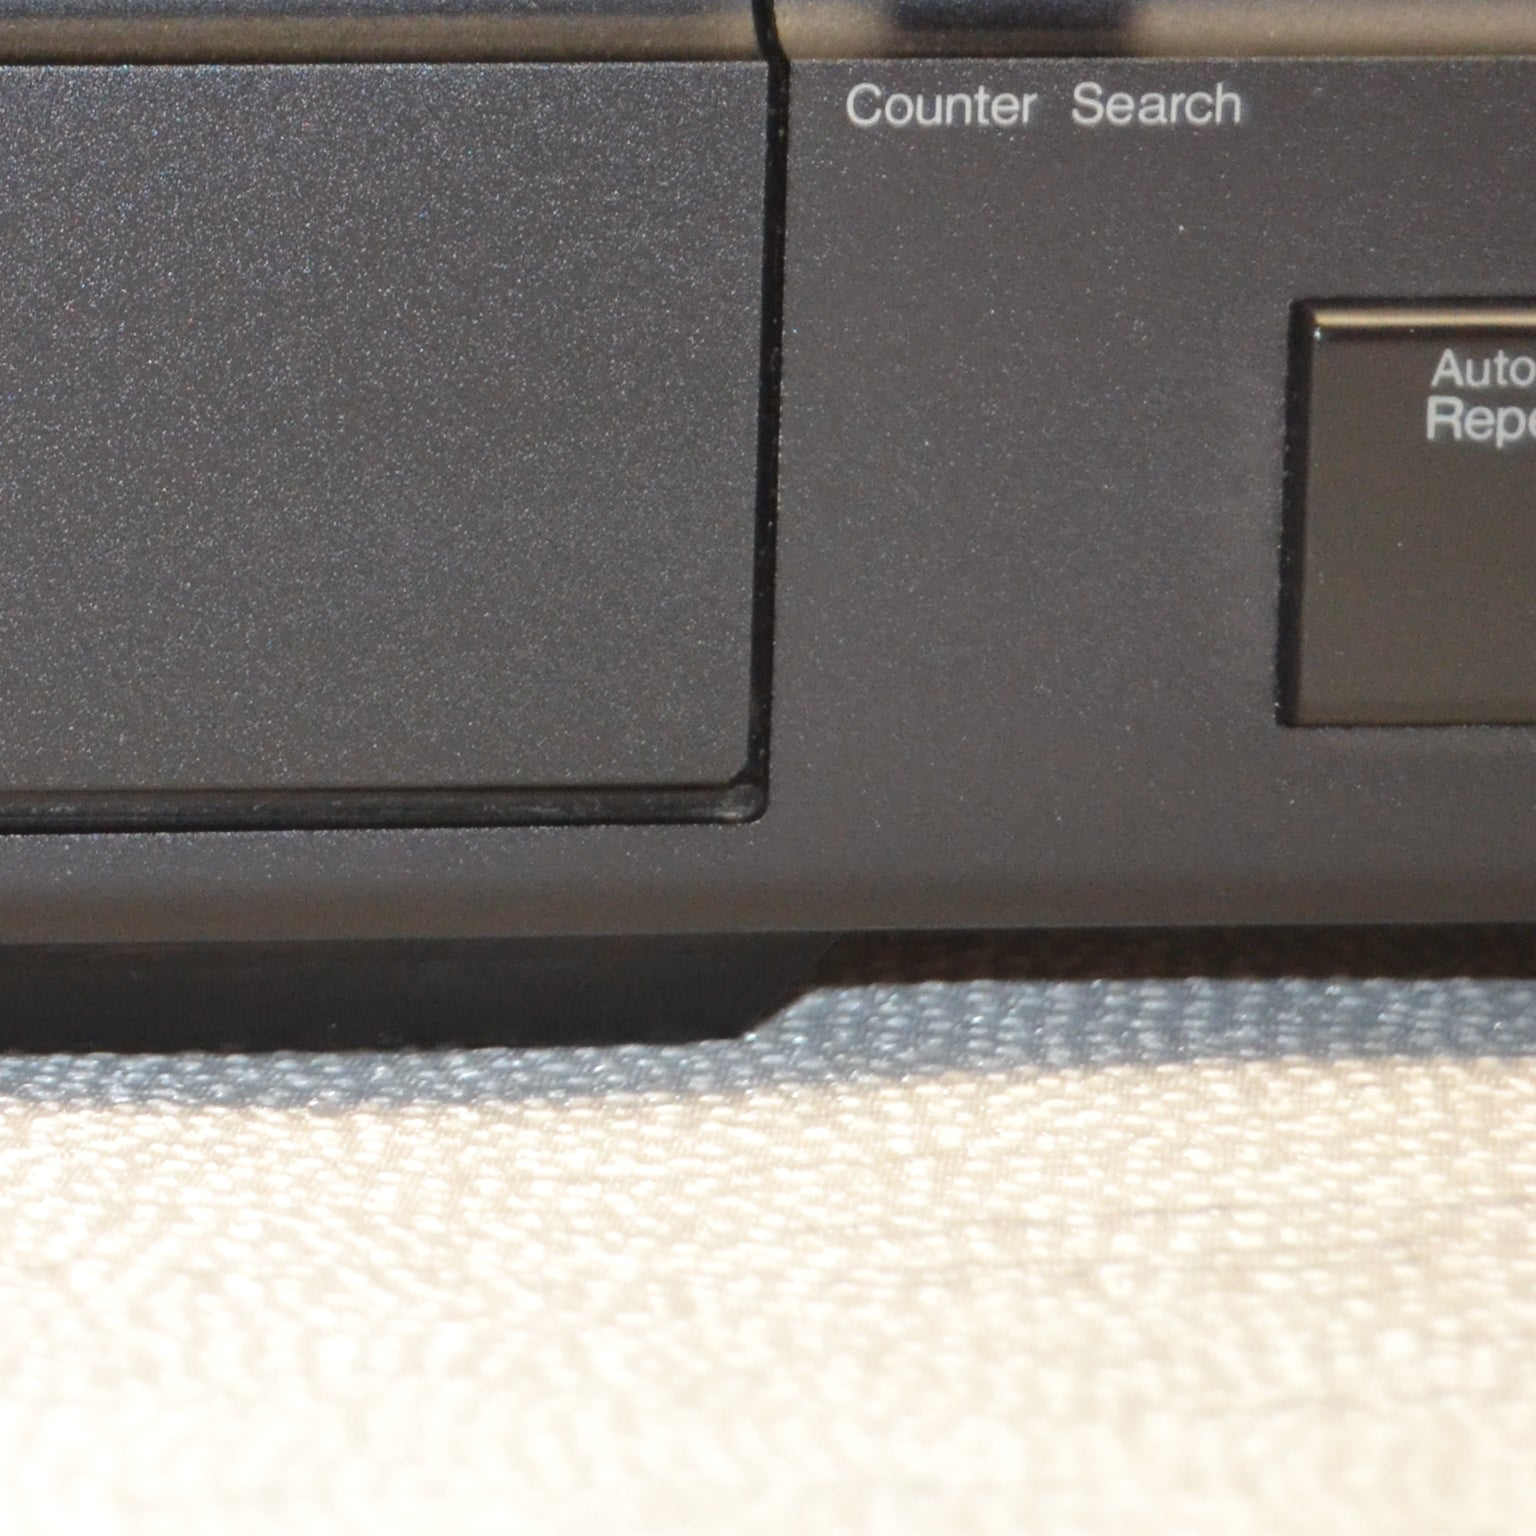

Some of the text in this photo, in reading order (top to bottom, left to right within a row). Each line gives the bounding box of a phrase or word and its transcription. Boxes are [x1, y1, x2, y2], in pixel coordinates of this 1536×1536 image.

[845, 81, 1243, 126] Counter Search
[1430, 347, 1536, 388] Auto
[1426, 394, 1536, 449] Rep
